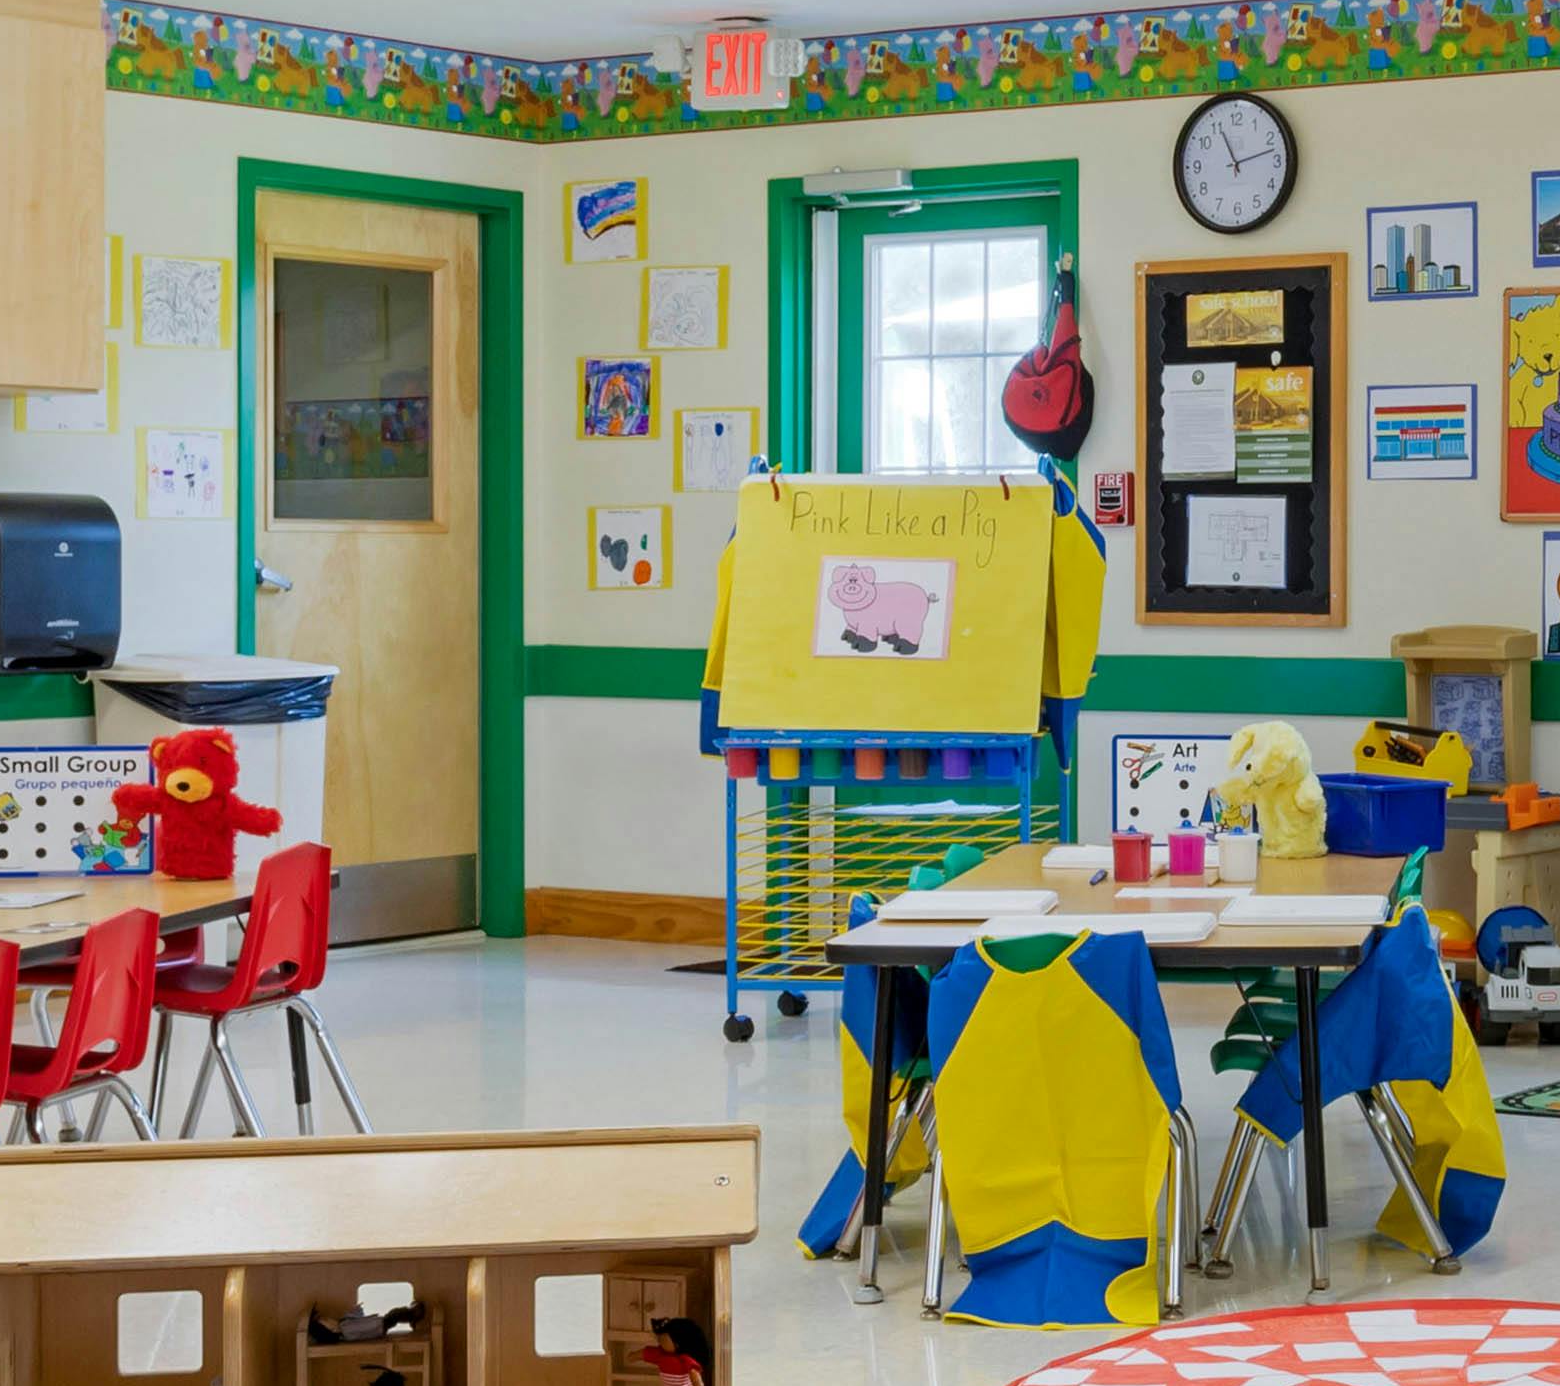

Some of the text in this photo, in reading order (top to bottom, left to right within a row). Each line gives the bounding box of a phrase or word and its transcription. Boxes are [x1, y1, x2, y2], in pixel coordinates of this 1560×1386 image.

[705, 32, 767, 97] EXIT
[1230, 112, 1243, 126] 12
[1253, 118, 1258, 132] 1
[1211, 122, 1223, 135] 11
[1199, 136, 1212, 150] 10
[1266, 131, 1275, 146] 2
[1193, 160, 1202, 174] 9
[1273, 154, 1282, 169] 3
[1199, 182, 1208, 196] 8
[1267, 178, 1275, 191] 4
[1215, 197, 1224, 211] 7
[1252, 194, 1261, 209] 5
[1233, 202, 1242, 216] 6
[1200, 295, 1225, 309] safe
[1265, 371, 1304, 392] safe
[1097, 473, 1122, 486] FIRE
[790, 489, 997, 569] Pink Like a Pig
[1172, 743, 1198, 758] Art
[0, 756, 137, 776] Small Group
[1173, 763, 1196, 773] Arte
[15, 777, 122, 791] Grupo pequeño
